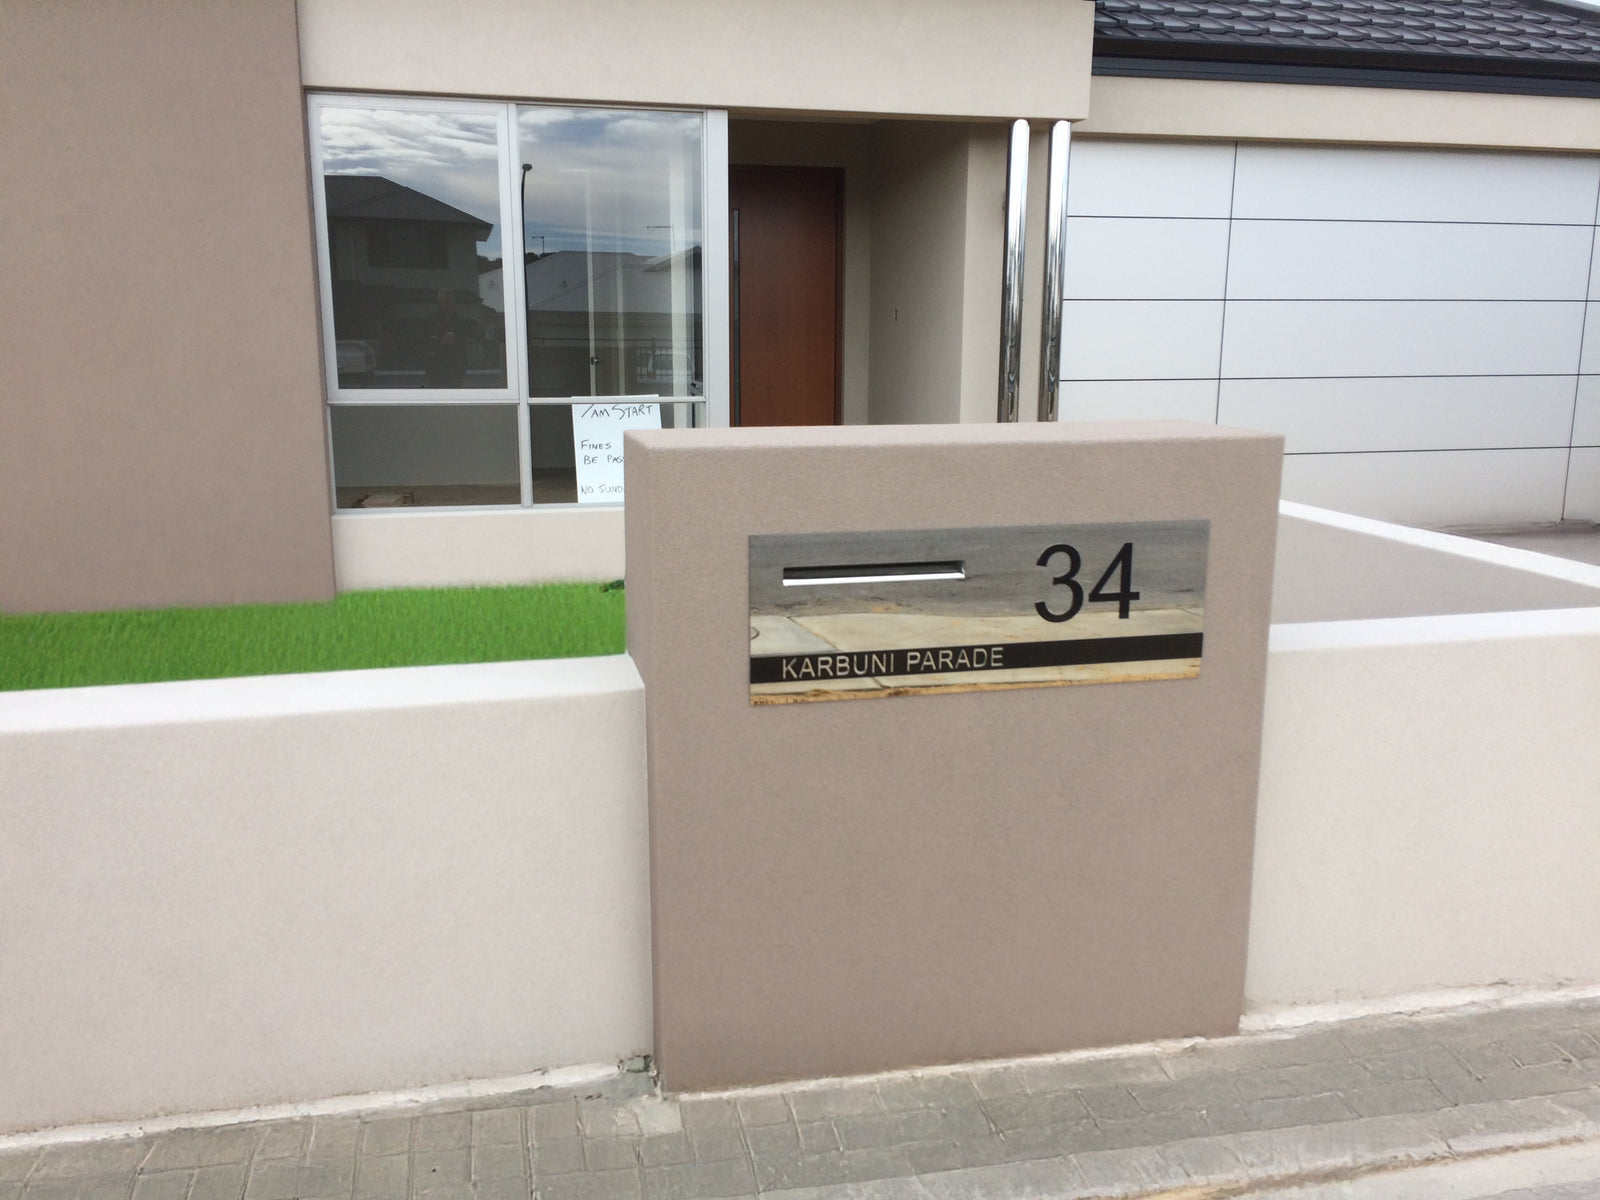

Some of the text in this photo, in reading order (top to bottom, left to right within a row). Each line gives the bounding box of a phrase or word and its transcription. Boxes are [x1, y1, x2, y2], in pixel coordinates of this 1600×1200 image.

[612, 403, 653, 420] START
[581, 439, 612, 450] FINES
[583, 455, 598, 465] BE
[581, 485, 594, 495] NO
[1034, 542, 1140, 622] 34
[782, 647, 1004, 679] KARBUNI PARADE
